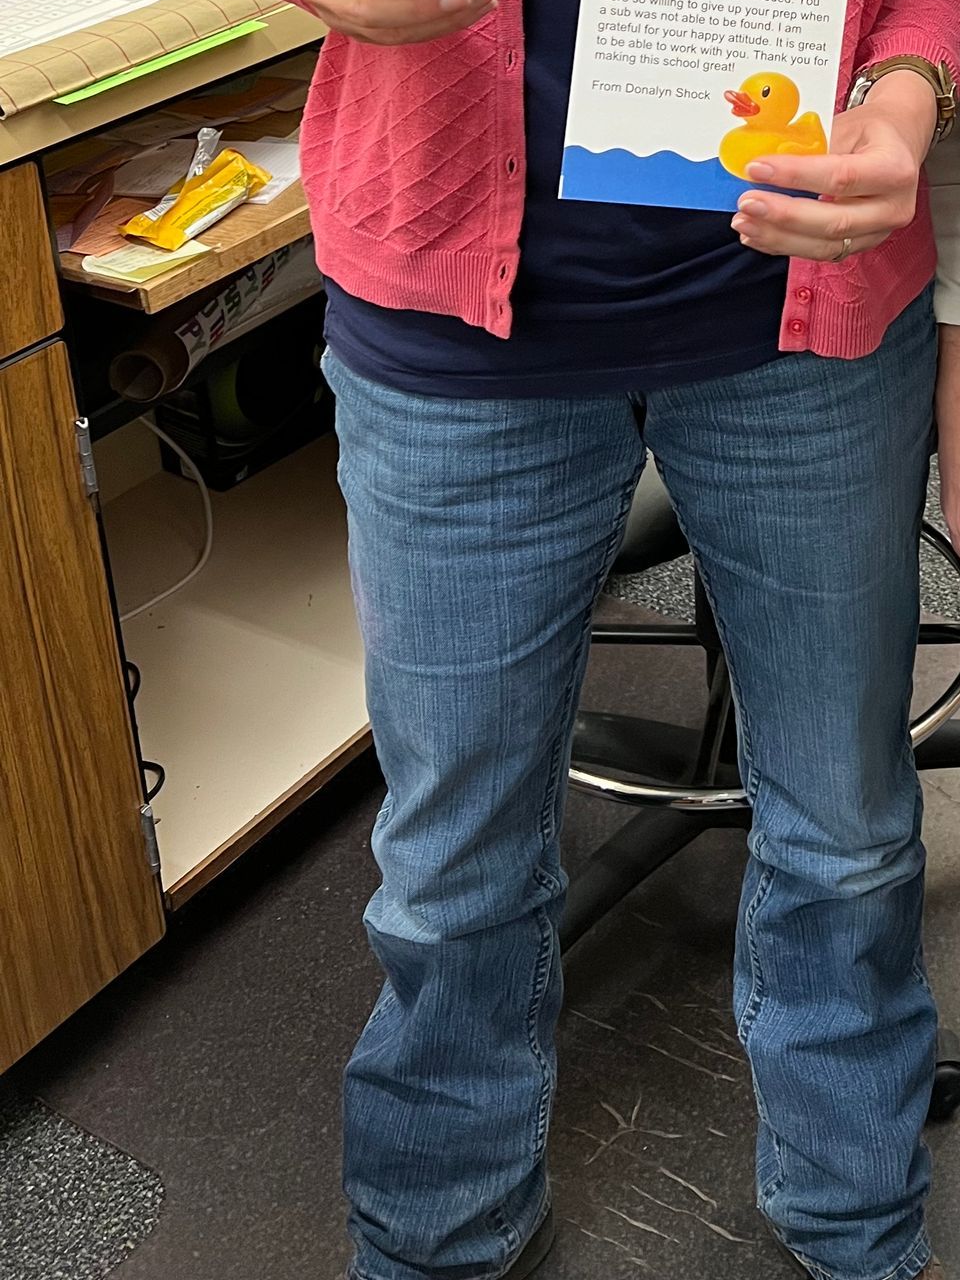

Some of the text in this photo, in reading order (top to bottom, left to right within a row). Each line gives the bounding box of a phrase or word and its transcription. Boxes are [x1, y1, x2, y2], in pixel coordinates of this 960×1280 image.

[610, 7, 631, 17] sub
[634, 10, 657, 19] was
[660, 12, 678, 22] not
[681, 14, 705, 24] able
[709, 16, 719, 26] to
[723, 16, 737, 27] be
[740, 18, 774, 31] found.
[778, 22, 781, 32] I
[784, 25, 802, 34] am
[688, 0, 698, 9] to
[701, 0, 724, 12] give
[728, 5, 742, 15] up
[744, 6, 770, 17] your
[772, 10, 797, 21] prep
[800, 11, 829, 22] when
[598, 22, 826, 52] grateful for your happy attitude. It is great
[595, 50, 735, 72] making this school great!
[597, 36, 828, 66] to be able to work with you. Thank you for
[592, 80, 710, 100] From Donalyn Shock
